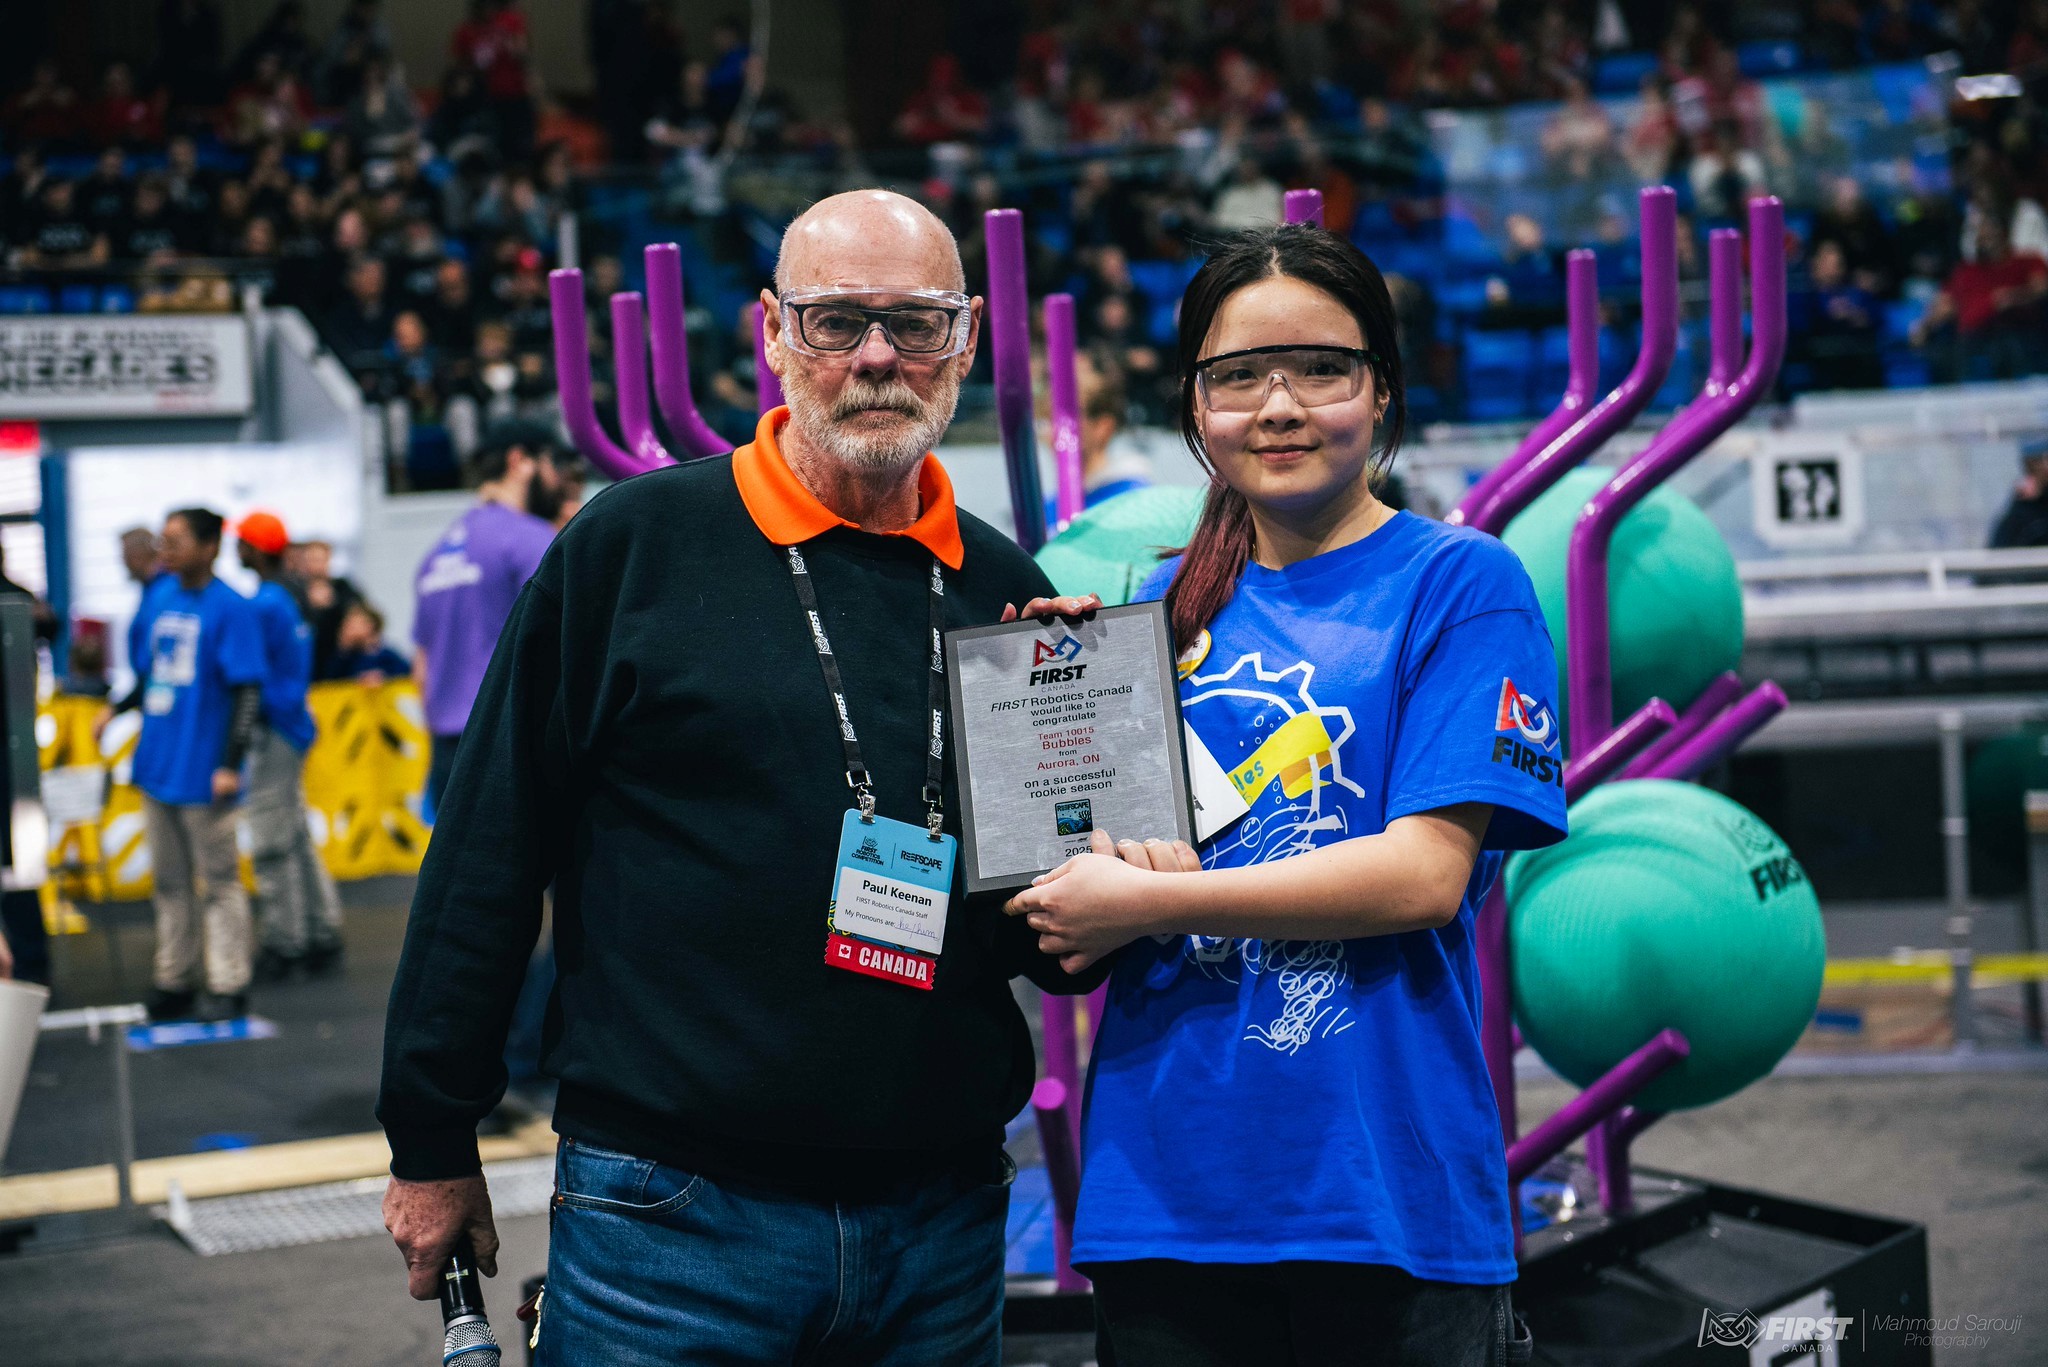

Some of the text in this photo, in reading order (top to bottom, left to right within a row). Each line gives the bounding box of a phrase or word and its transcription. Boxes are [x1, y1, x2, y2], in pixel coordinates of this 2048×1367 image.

[933, 627, 942, 656] FIRST
[1029, 664, 1087, 686] FIRST
[1041, 683, 1075, 692] CANADA
[834, 692, 849, 721] FIRST
[991, 685, 1133, 712] FIRST Robotics Canada
[1030, 701, 1096, 717] would like to
[932, 709, 942, 738] FIRST
[1032, 711, 1097, 727] congratulate
[1038, 726, 1095, 741] Team 10015
[1042, 736, 1092, 750] Bubbles
[1058, 749, 1077, 757] from
[1082, 753, 1100, 764] ON
[1024, 767, 1116, 789] on a successful
[1030, 780, 1112, 799] rookie season
[851, 852, 885, 866] COMPETITION
[861, 845, 877, 854] FIRST
[901, 850, 943, 871] REEFSCAPE
[862, 879, 932, 906] Paul Keenan
[844, 908, 855, 918] My
[856, 911, 884, 924] Pronouns
[856, 896, 929, 919] FIRST Robotics Canada Staff
[859, 946, 928, 981] CANADA
